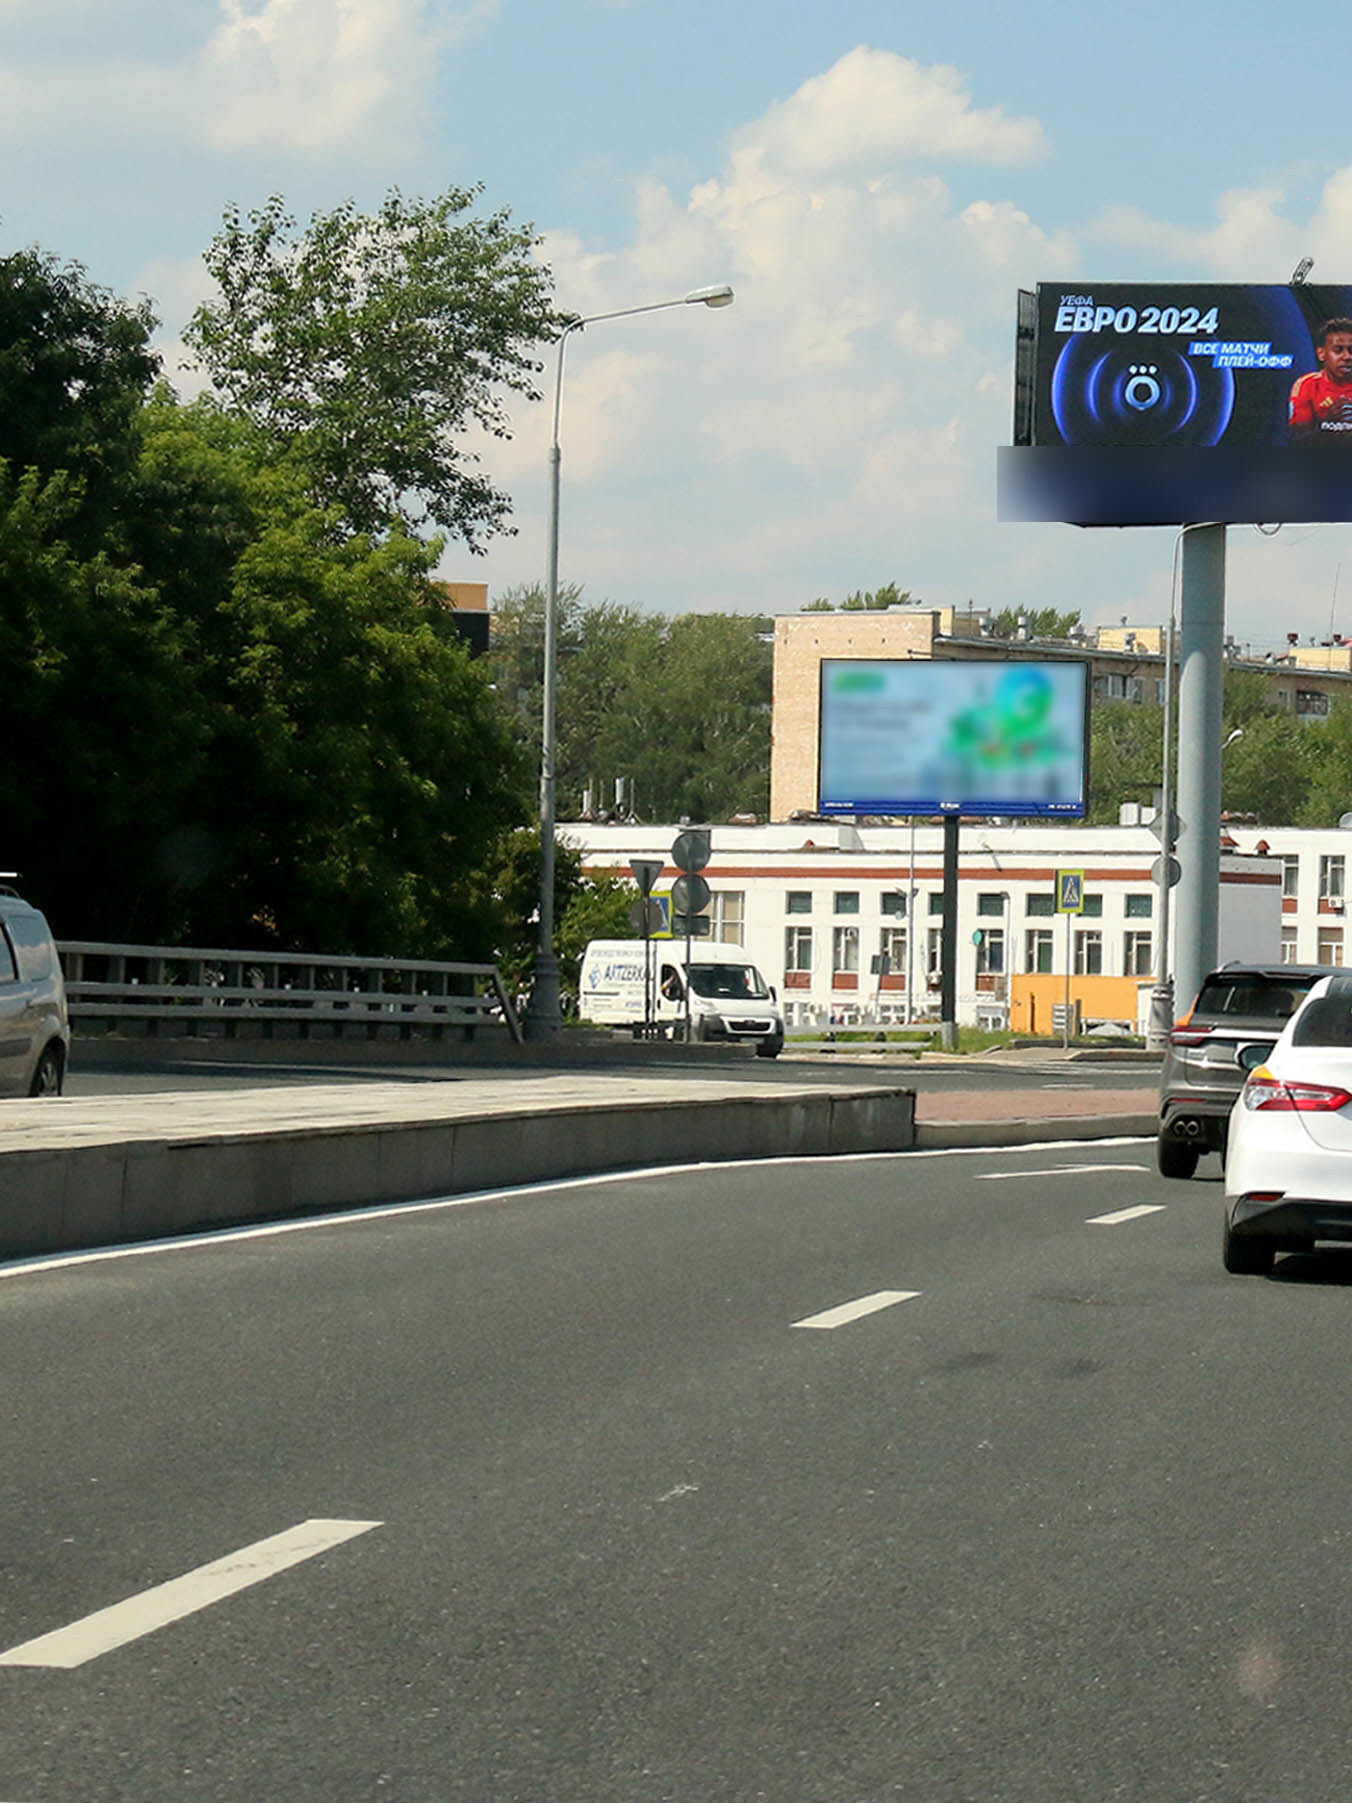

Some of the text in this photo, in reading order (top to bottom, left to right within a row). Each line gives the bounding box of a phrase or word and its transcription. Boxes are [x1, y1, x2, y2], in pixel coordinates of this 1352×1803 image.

[1060, 295, 1094, 306] УЕФА
[1054, 307, 1219, 334] ЕВРО 2024
[1192, 342, 1270, 355] ВСЕ МАТЧИ
[1217, 355, 1293, 368] ПЛЕЙ-ОФФ
